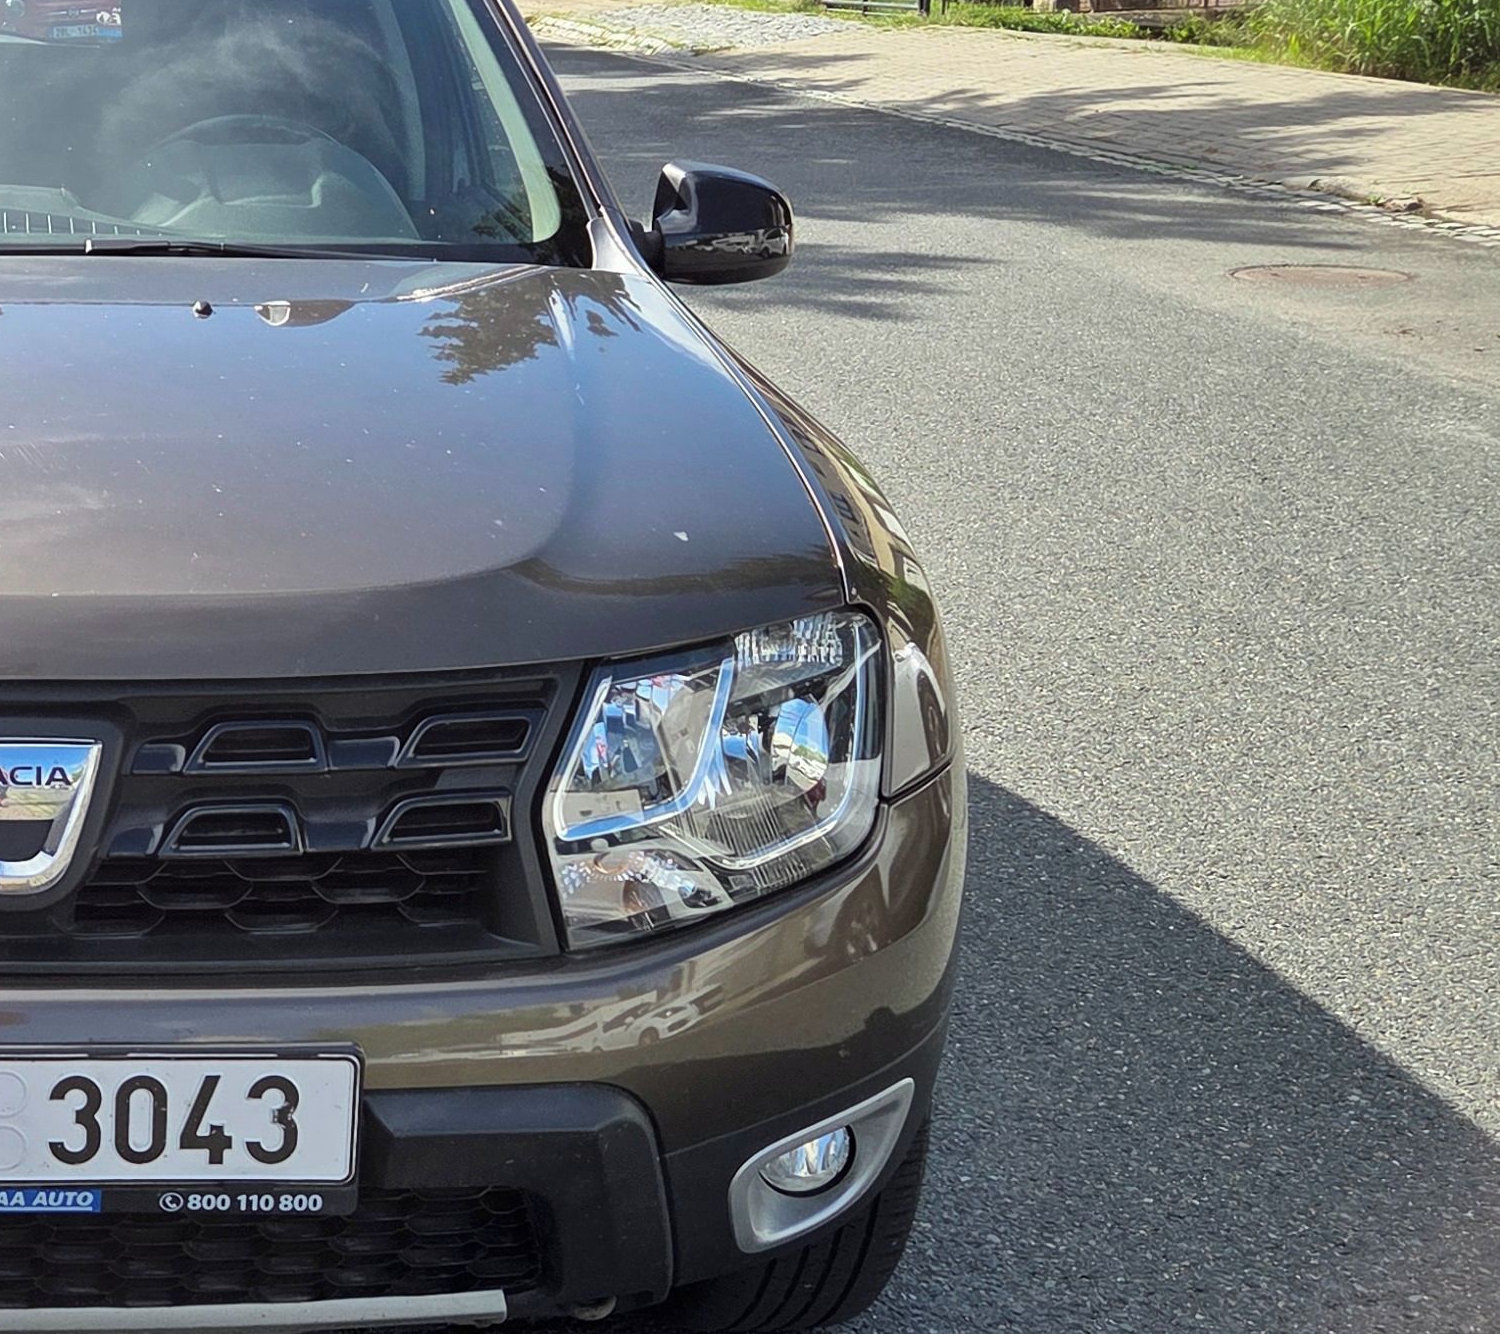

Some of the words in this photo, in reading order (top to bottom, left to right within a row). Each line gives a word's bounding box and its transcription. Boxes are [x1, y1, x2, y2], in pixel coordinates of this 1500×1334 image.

[47, 1074, 300, 1166] 3043
[32, 1190, 94, 1207] AUTO
[187, 1193, 231, 1211] 800
[236, 1194, 274, 1211] 110
[279, 1194, 323, 1212] 800
